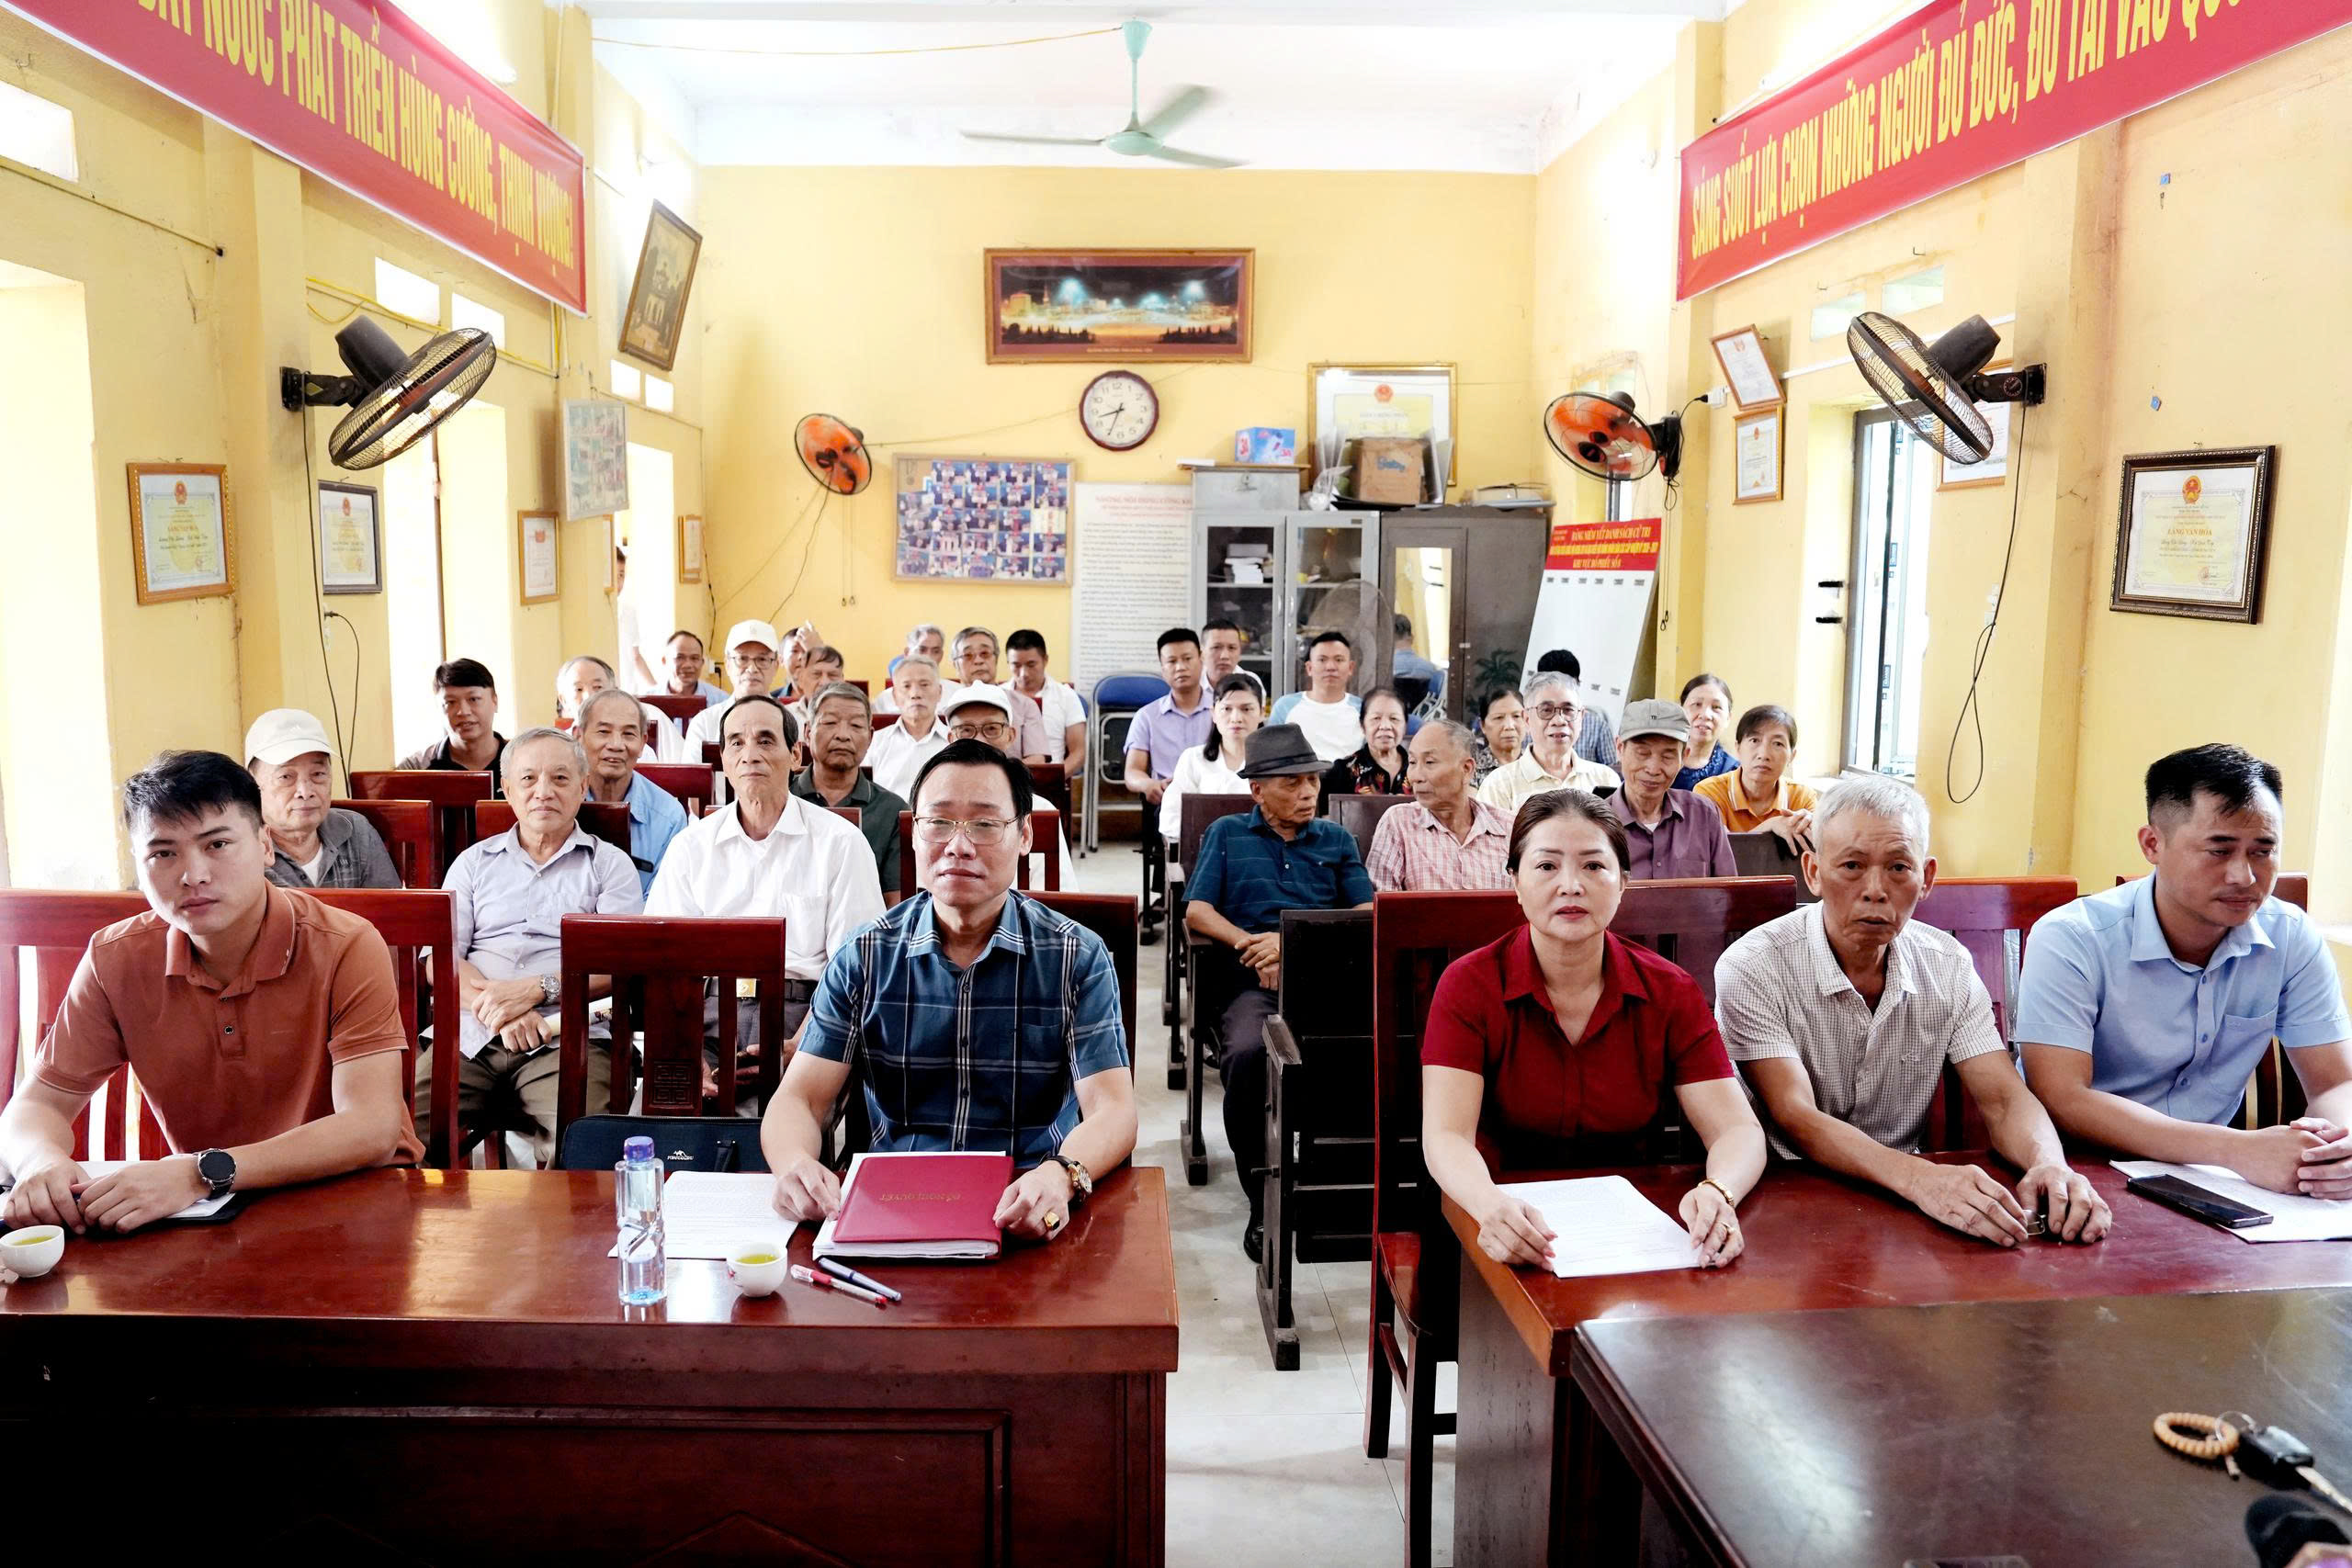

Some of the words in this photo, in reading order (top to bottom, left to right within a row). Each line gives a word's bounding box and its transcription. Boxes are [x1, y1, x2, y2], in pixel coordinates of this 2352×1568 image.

[340, 6, 396, 162] TRIỂN
[399, 54, 444, 192] HÙNG
[447, 95, 498, 236] CƯỜNG,
[499, 141, 535, 257] THỊNH
[1691, 165, 1721, 260] SÁNG
[1723, 128, 1753, 245] SUỐT
[1754, 133, 1778, 245] LỰA
[1781, 115, 1819, 229] CHỌN
[1820, 77, 1876, 199] NHỮNG
[1878, 28, 1935, 172] NGƯỜI
[1937, 0, 1968, 144] ĐỦ
